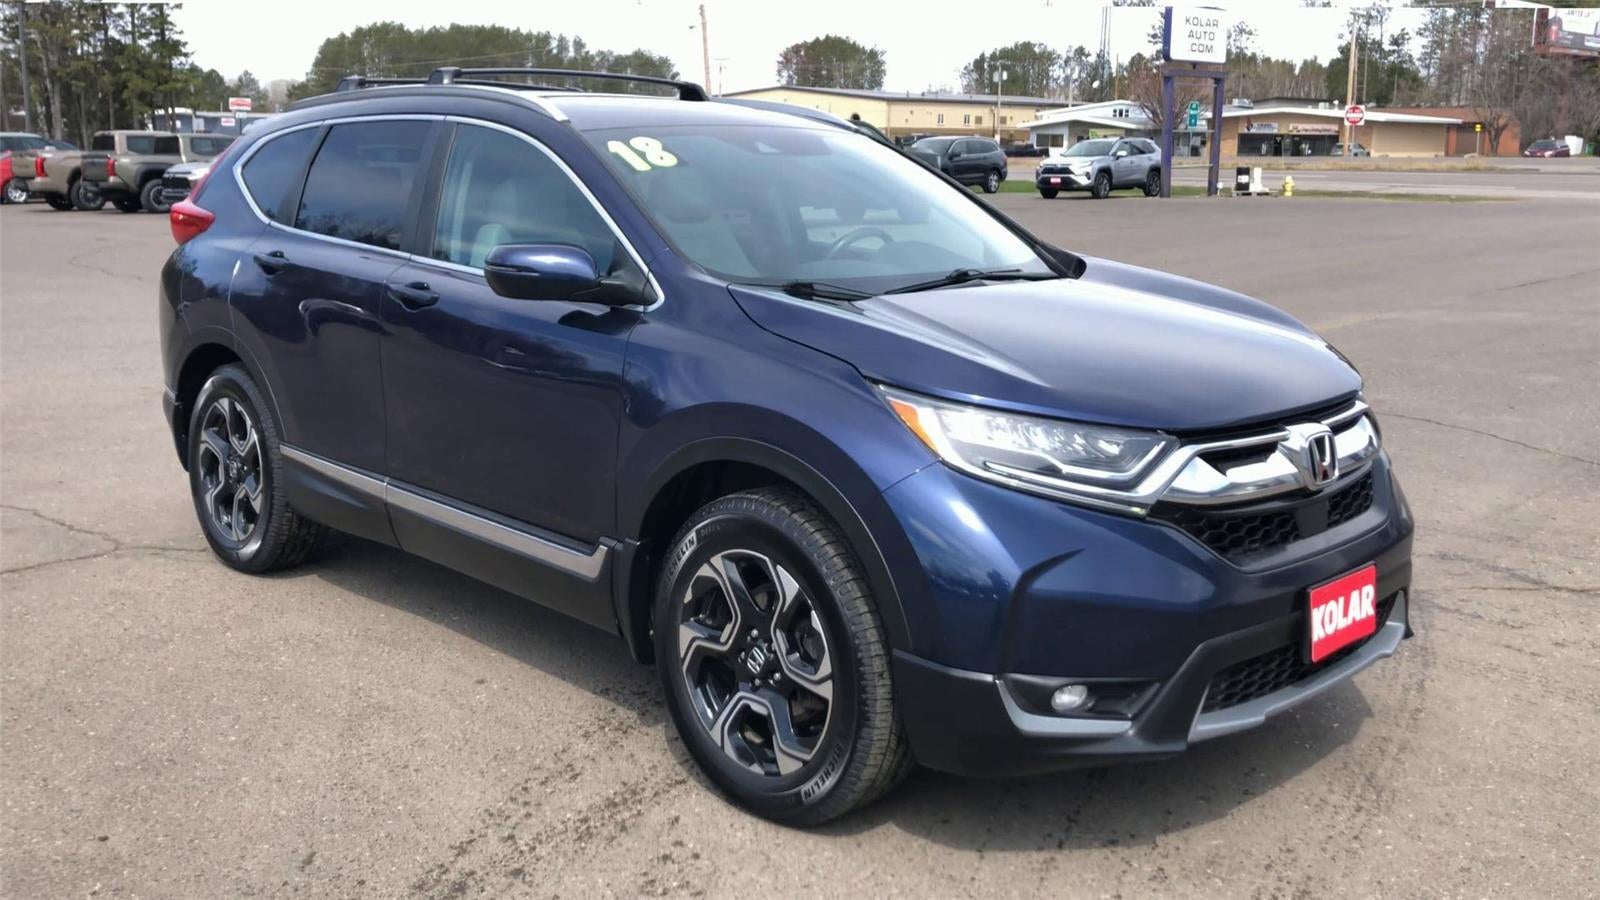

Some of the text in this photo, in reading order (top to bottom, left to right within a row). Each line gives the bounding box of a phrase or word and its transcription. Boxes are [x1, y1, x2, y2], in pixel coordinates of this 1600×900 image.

[1185, 16, 1219, 28] KOLAR
[1188, 29, 1215, 41] AUTO
[607, 136, 678, 171] 18
[1311, 584, 1375, 643] KOLAR
